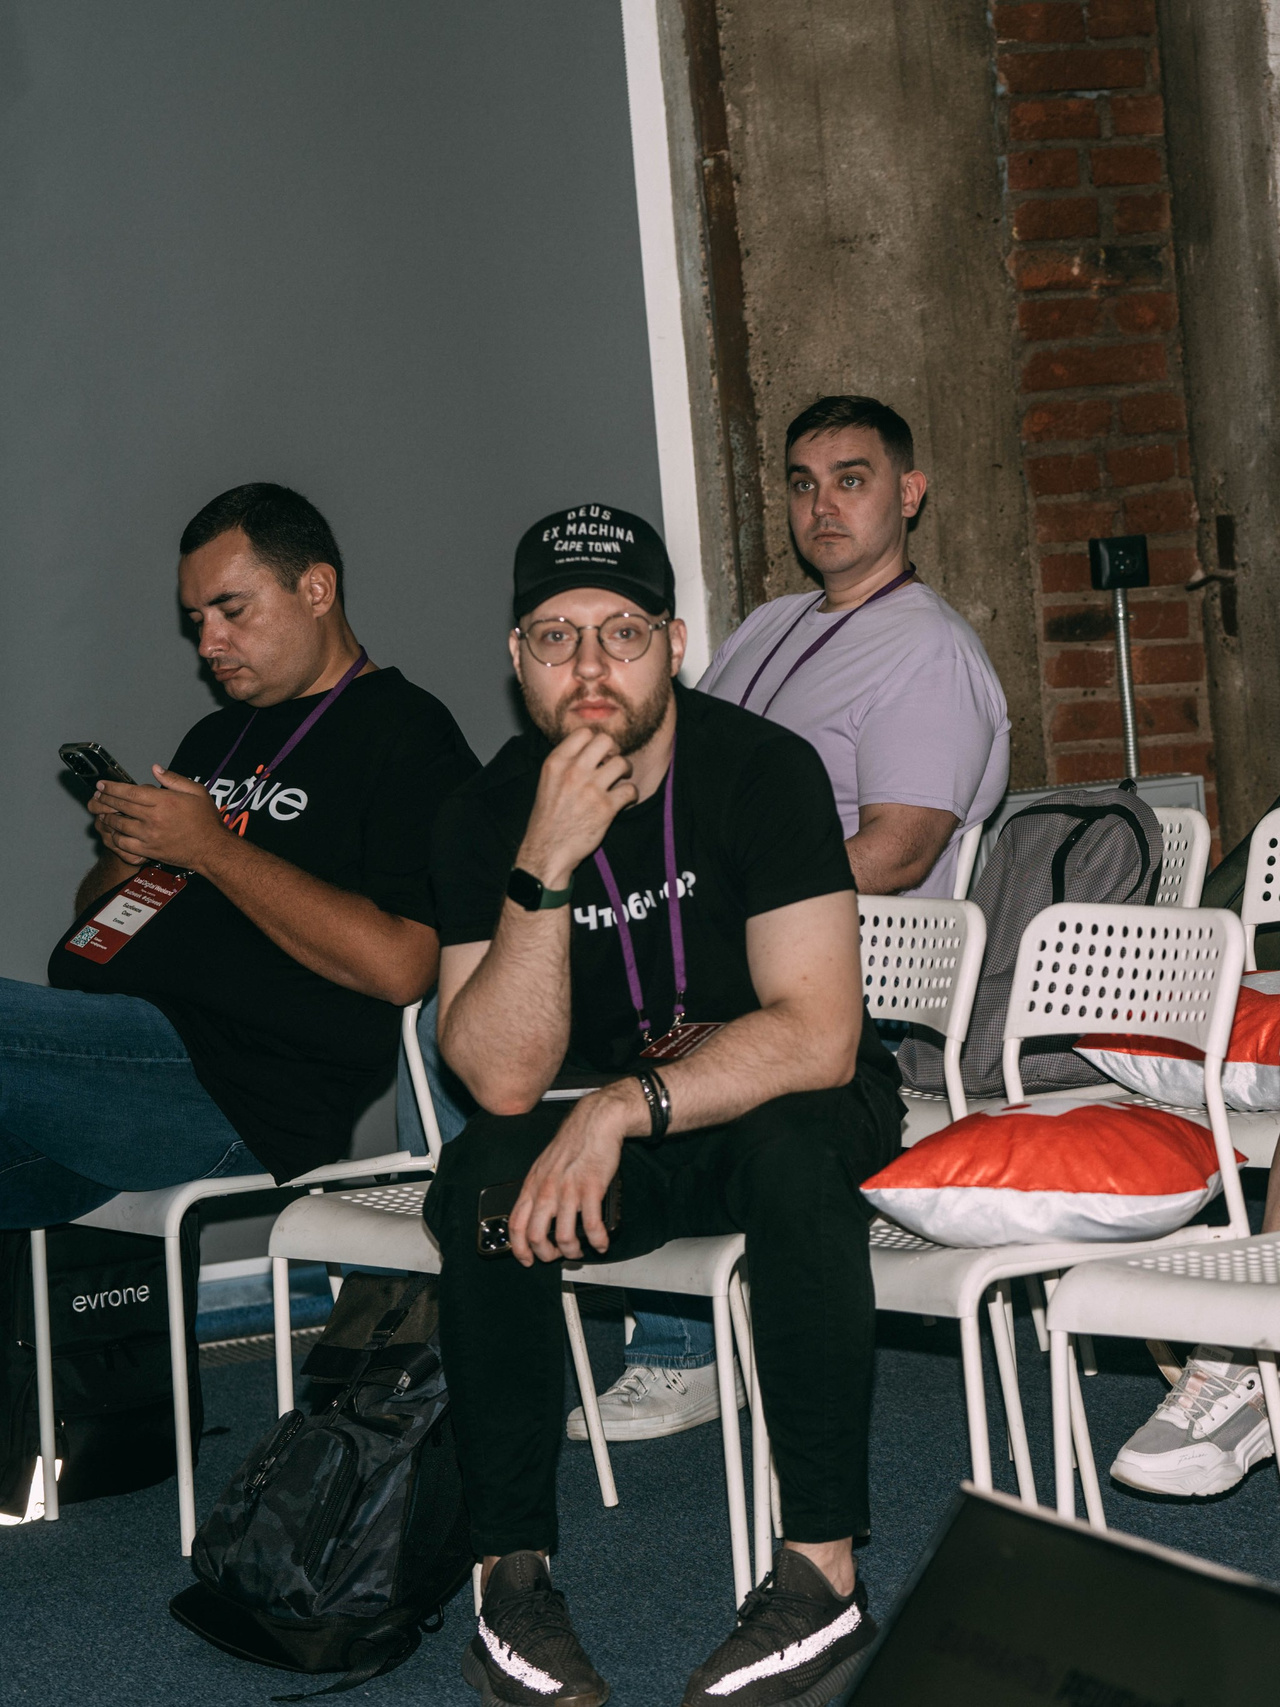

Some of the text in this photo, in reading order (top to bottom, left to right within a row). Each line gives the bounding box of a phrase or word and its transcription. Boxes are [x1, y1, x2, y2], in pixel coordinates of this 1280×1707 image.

[567, 505, 612, 521] DEUS
[542, 522, 635, 544] EX MACHINA
[554, 539, 621, 553] CAPE TOWN
[72, 1284, 150, 1312] evrone
